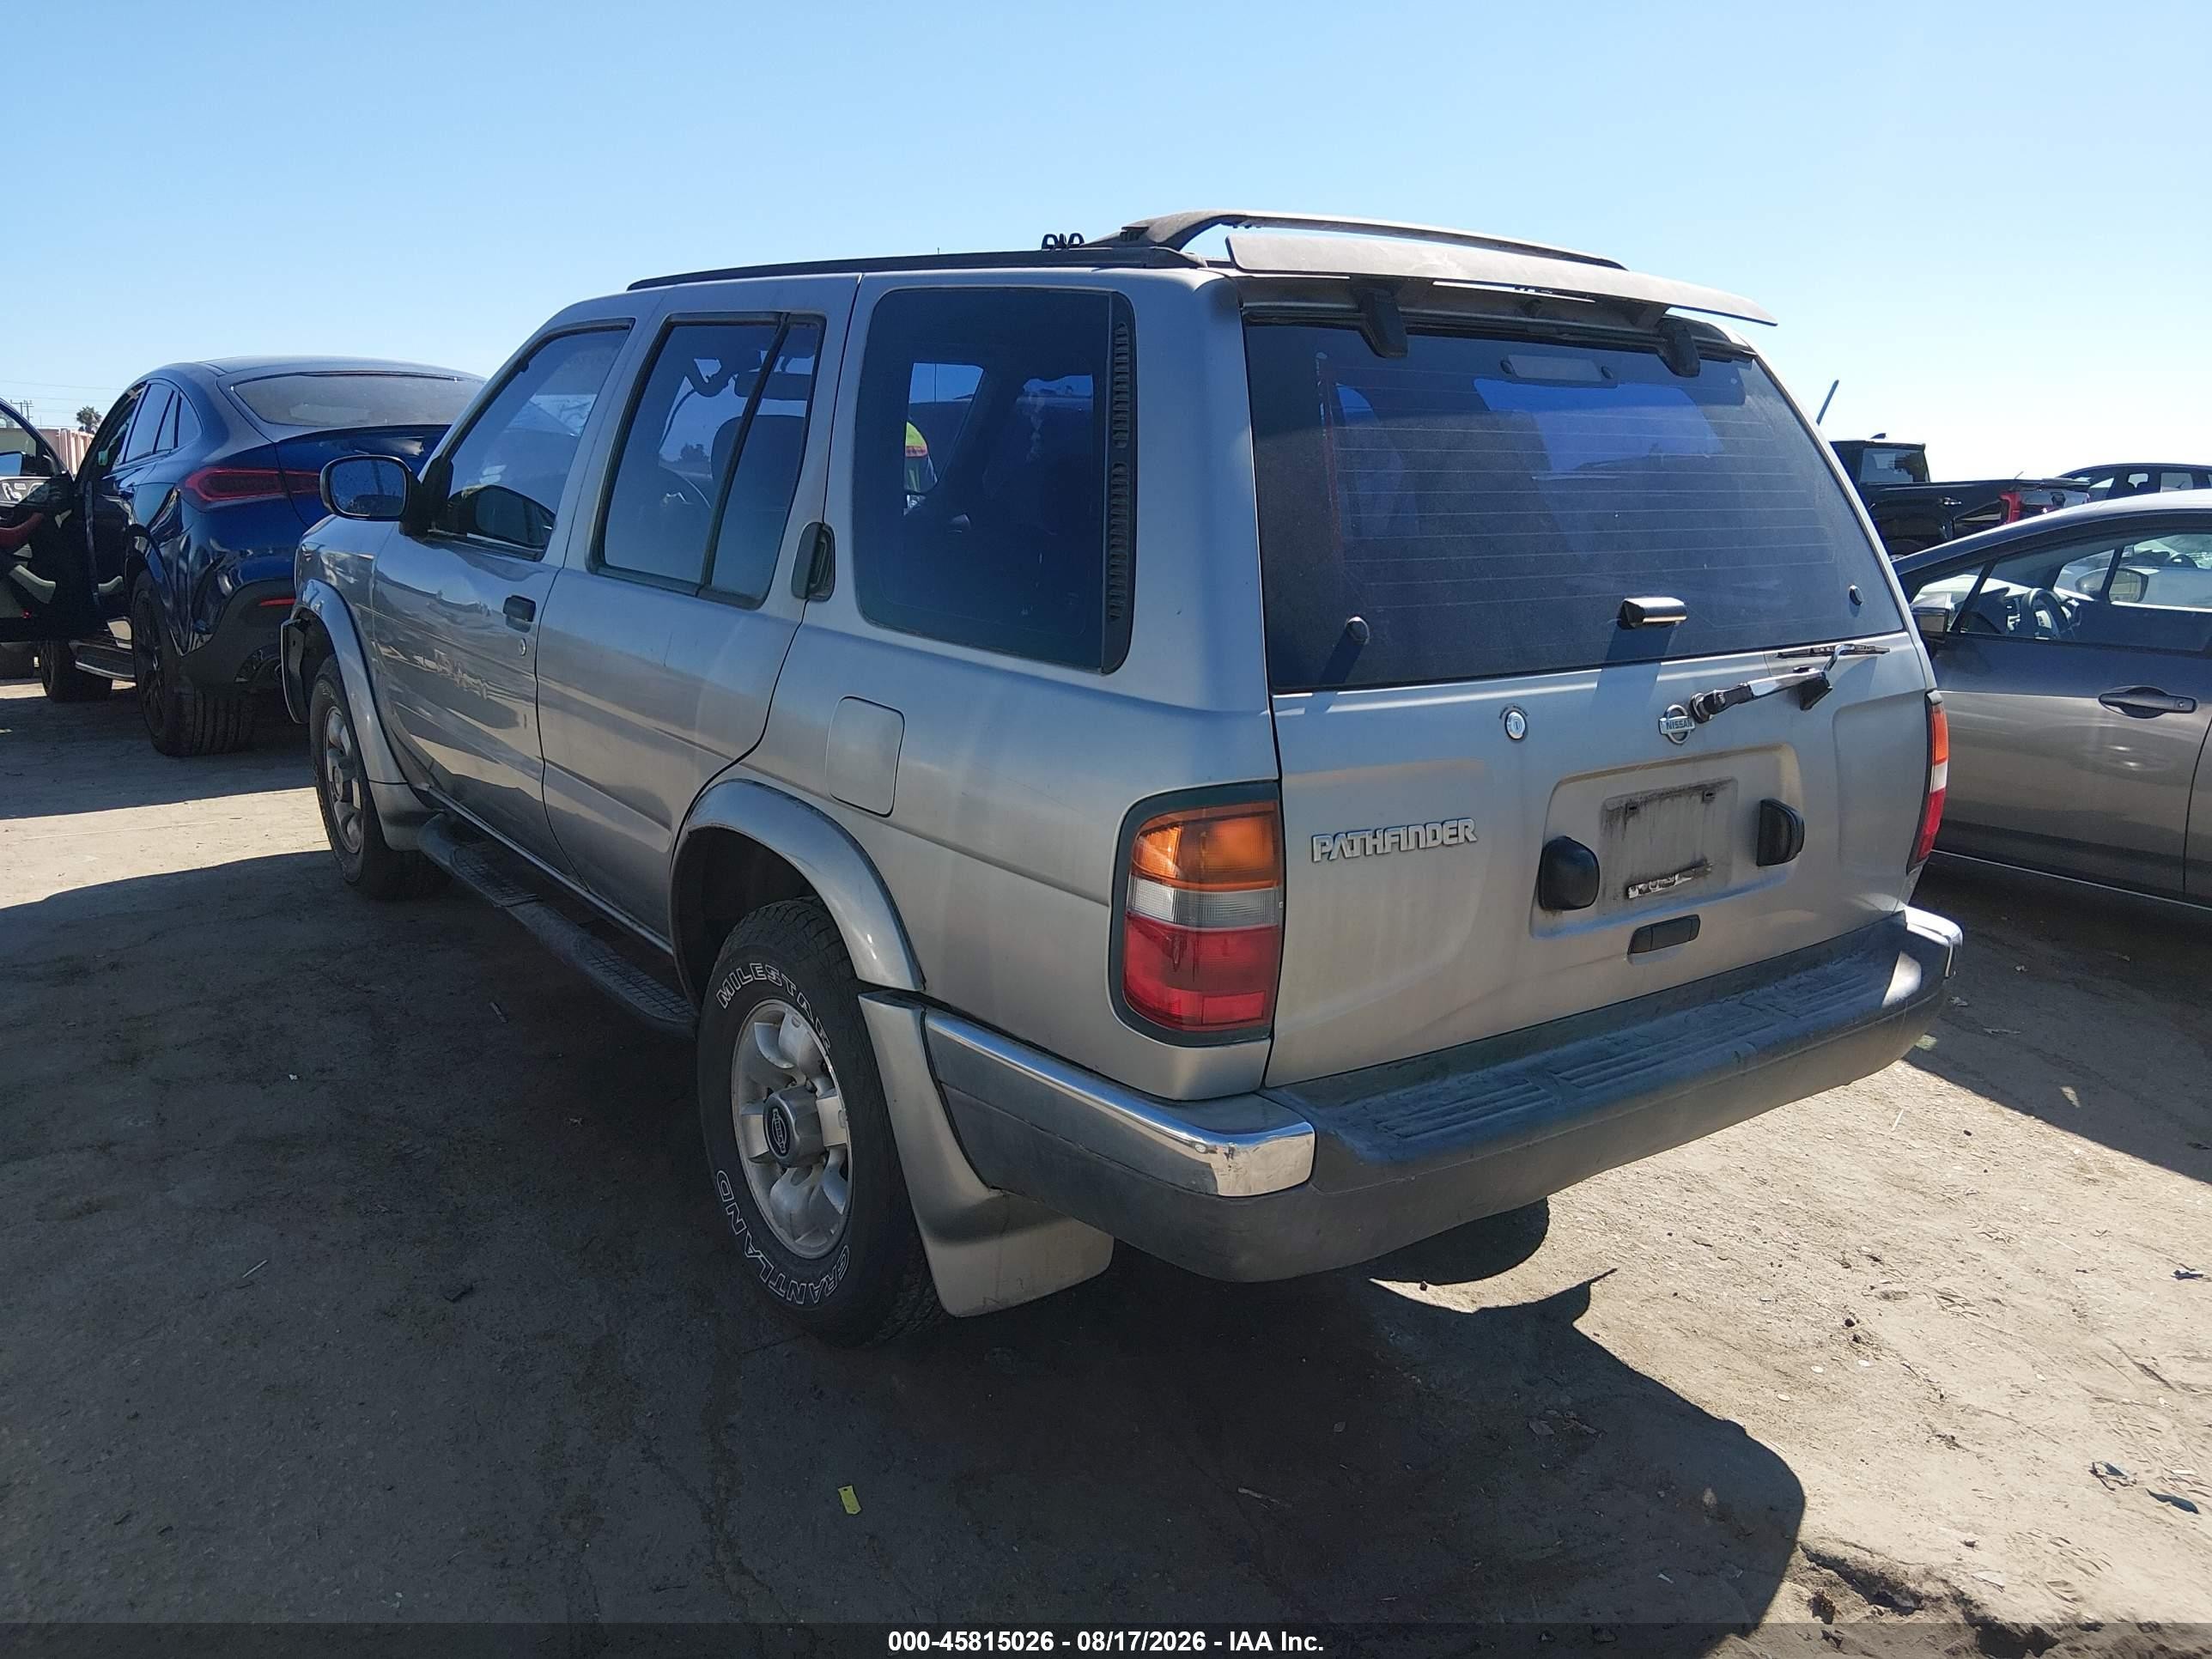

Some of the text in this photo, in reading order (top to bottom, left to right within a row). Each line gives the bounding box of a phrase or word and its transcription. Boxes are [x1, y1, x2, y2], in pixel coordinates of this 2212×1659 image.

[1312, 817, 1478, 862] PATHFINDER
[715, 963, 831, 1053] MILESTAR
[716, 1170, 849, 1304] GRANTLAND
